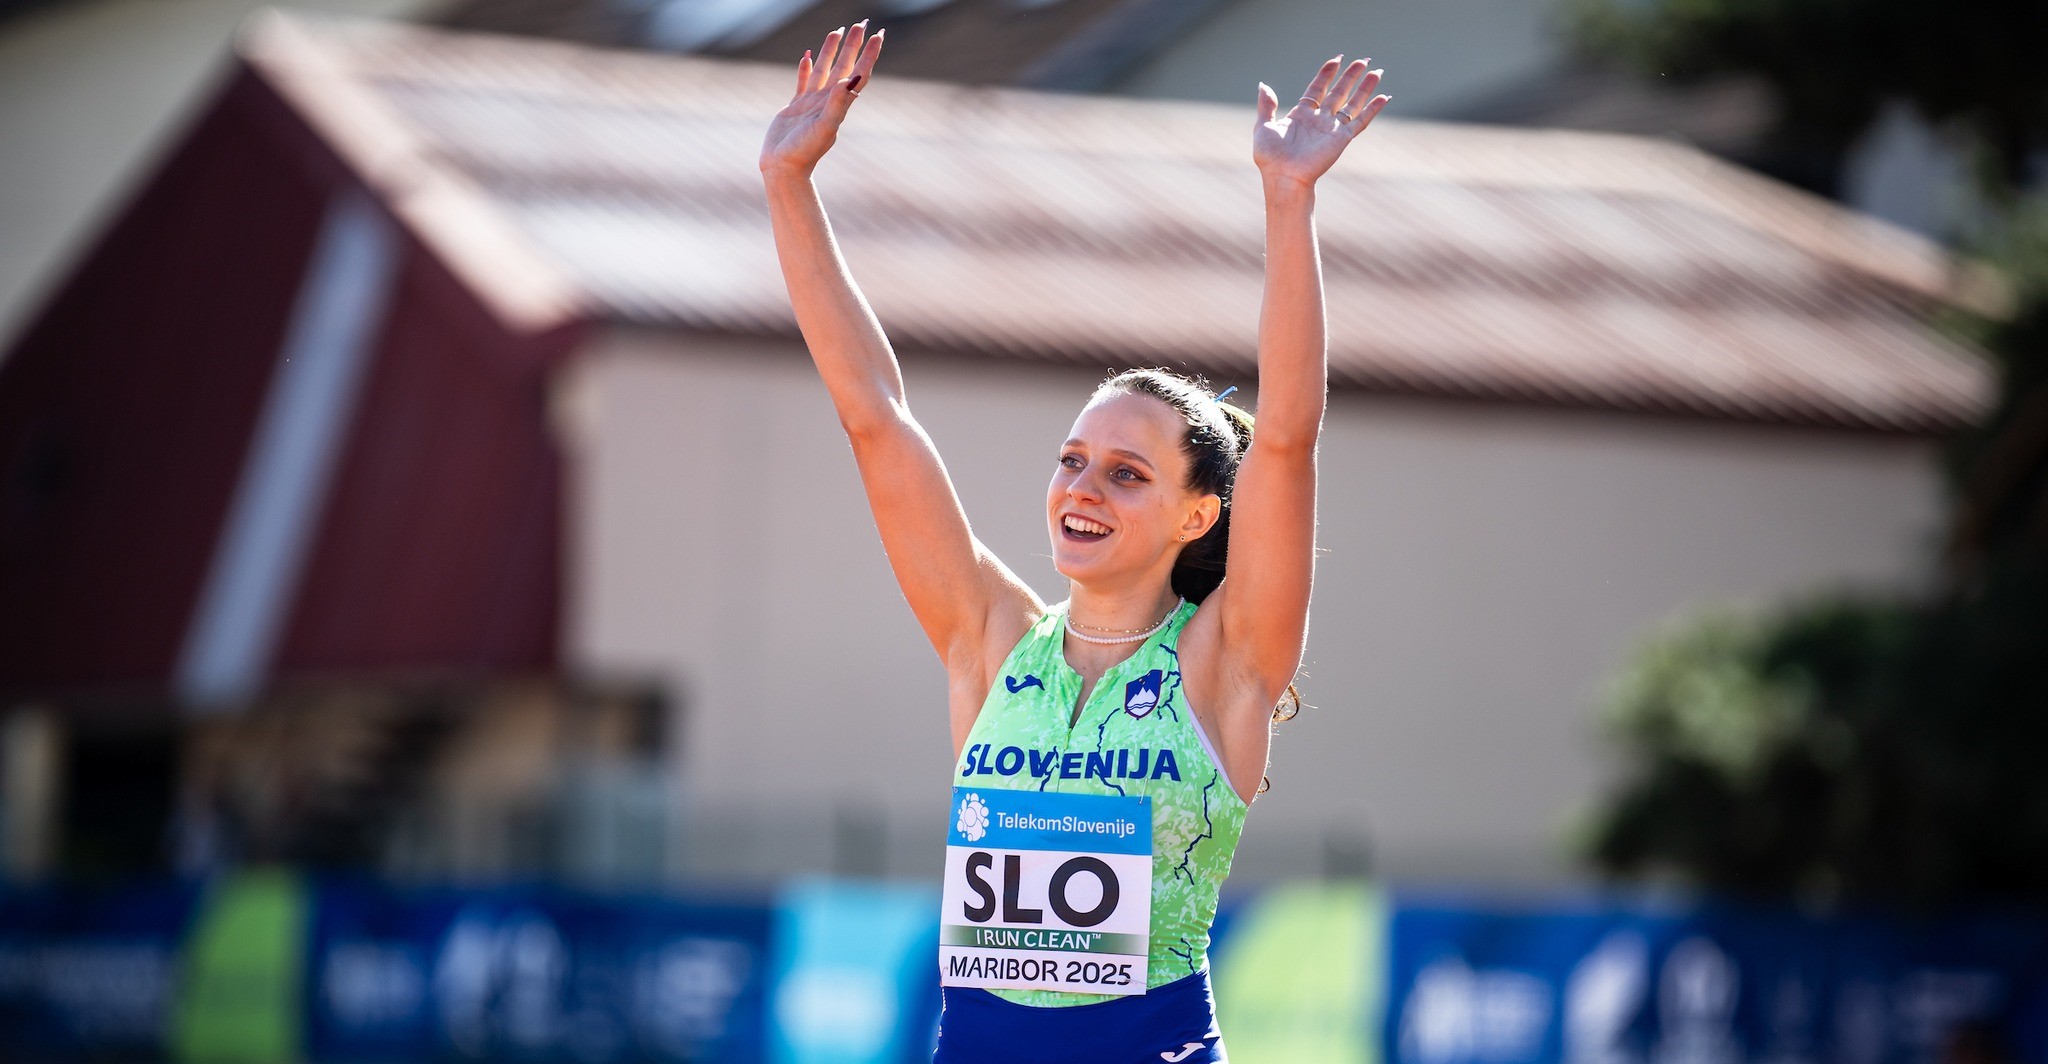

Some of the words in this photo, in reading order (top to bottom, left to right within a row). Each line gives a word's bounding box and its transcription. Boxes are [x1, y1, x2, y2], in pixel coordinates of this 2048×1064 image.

[962, 744, 1181, 782] SLOVENIJA
[963, 852, 1120, 928] SLO
[976, 929, 981, 946] I
[984, 929, 1020, 947] RUN
[949, 955, 1058, 982] MARIBOR
[1066, 960, 1132, 986] 2025
